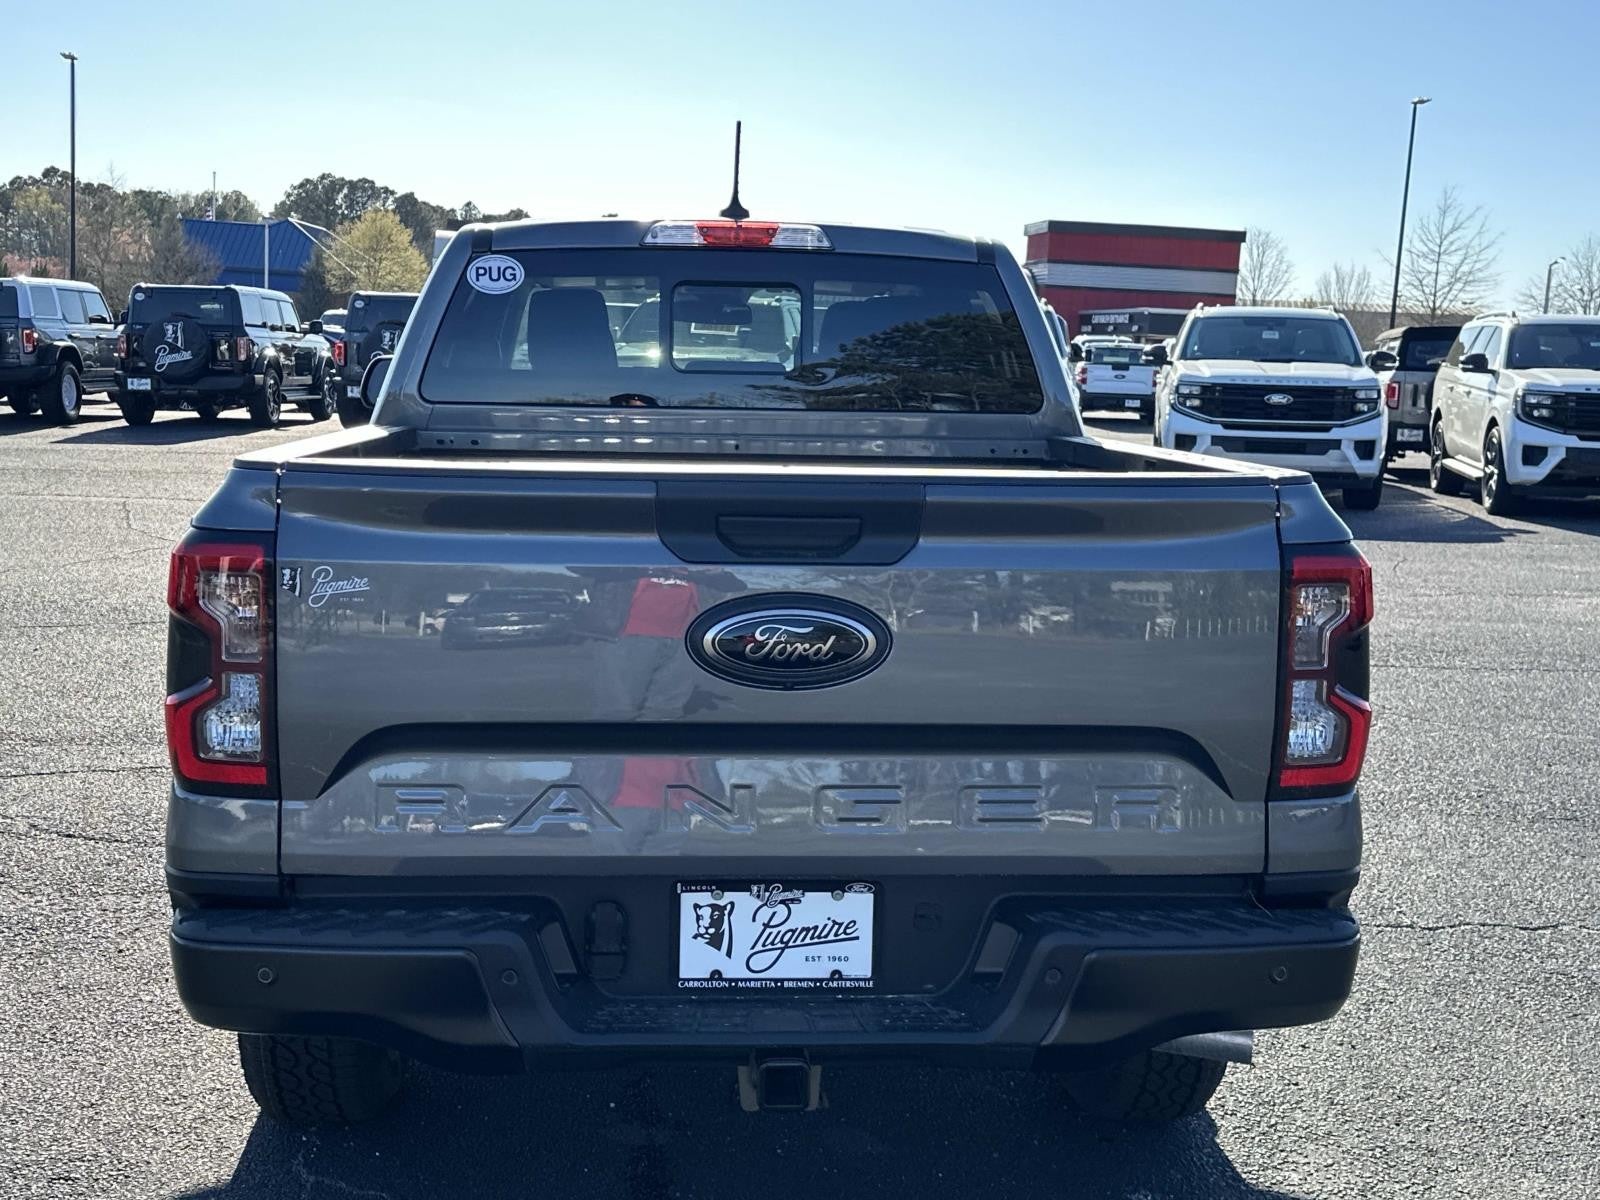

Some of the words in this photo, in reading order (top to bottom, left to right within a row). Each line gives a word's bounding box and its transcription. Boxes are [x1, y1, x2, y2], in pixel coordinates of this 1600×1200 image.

[475, 266, 517, 282] PUG
[308, 565, 370, 608] Pugmire
[744, 624, 837, 662] Ford
[375, 782, 1182, 834] RANGER
[850, 884, 869, 892] Ford
[745, 902, 860, 974] Pugmire
[805, 955, 821, 963] EST
[827, 955, 850, 963] 1960
[678, 980, 729, 988] CARROLLTON
[737, 980, 776, 988] MARIETTA
[783, 980, 815, 988] BREMEN
[822, 980, 874, 988] CARTERSVILLE
